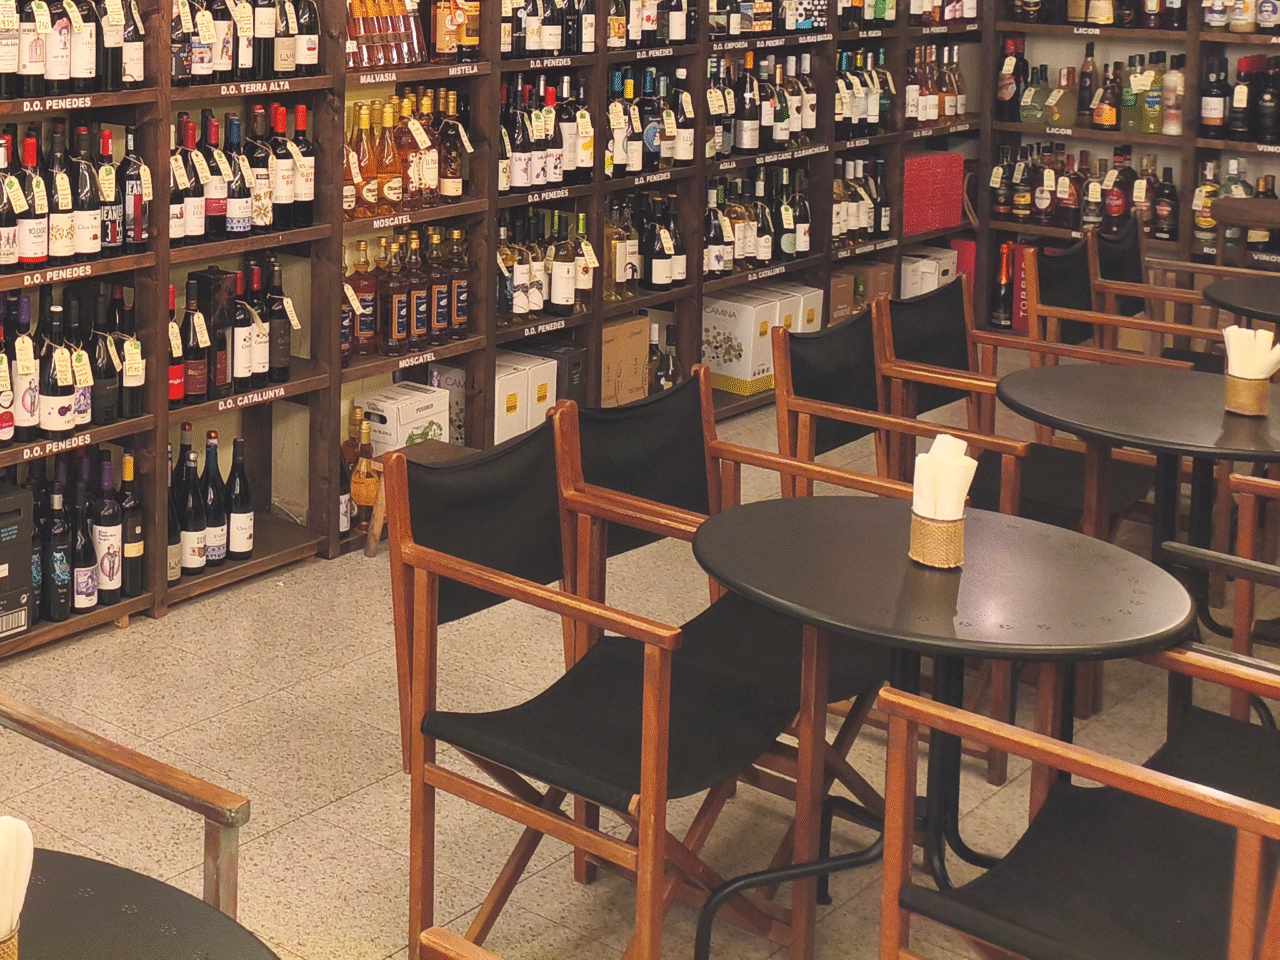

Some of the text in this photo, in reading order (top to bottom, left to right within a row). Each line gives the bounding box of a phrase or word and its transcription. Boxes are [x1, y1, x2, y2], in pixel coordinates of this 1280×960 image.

[1073, 27, 1101, 35] LICOR
[649, 48, 673, 58] PENEDES
[530, 57, 571, 68] D.O. PENEDES
[360, 72, 397, 84] MALVASIA
[448, 66, 478, 76] MISTELA
[221, 81, 290, 95] D.O. TERRA ALTA
[23, 98, 92, 112] D.O. PENEDES
[1046, 127, 1072, 136] LICOR
[540, 189, 569, 201] PENEDES
[373, 215, 412, 229] MOSCATEL
[23, 265, 92, 286] D.O. PENEDES
[703, 305, 738, 320] CAMINA
[537, 320, 565, 334] PENEDES
[399, 352, 436, 368] MOSCATEL
[218, 387, 285, 411] D.O. CATALUNYA
[23, 434, 91, 460] D.O. PENEDES
